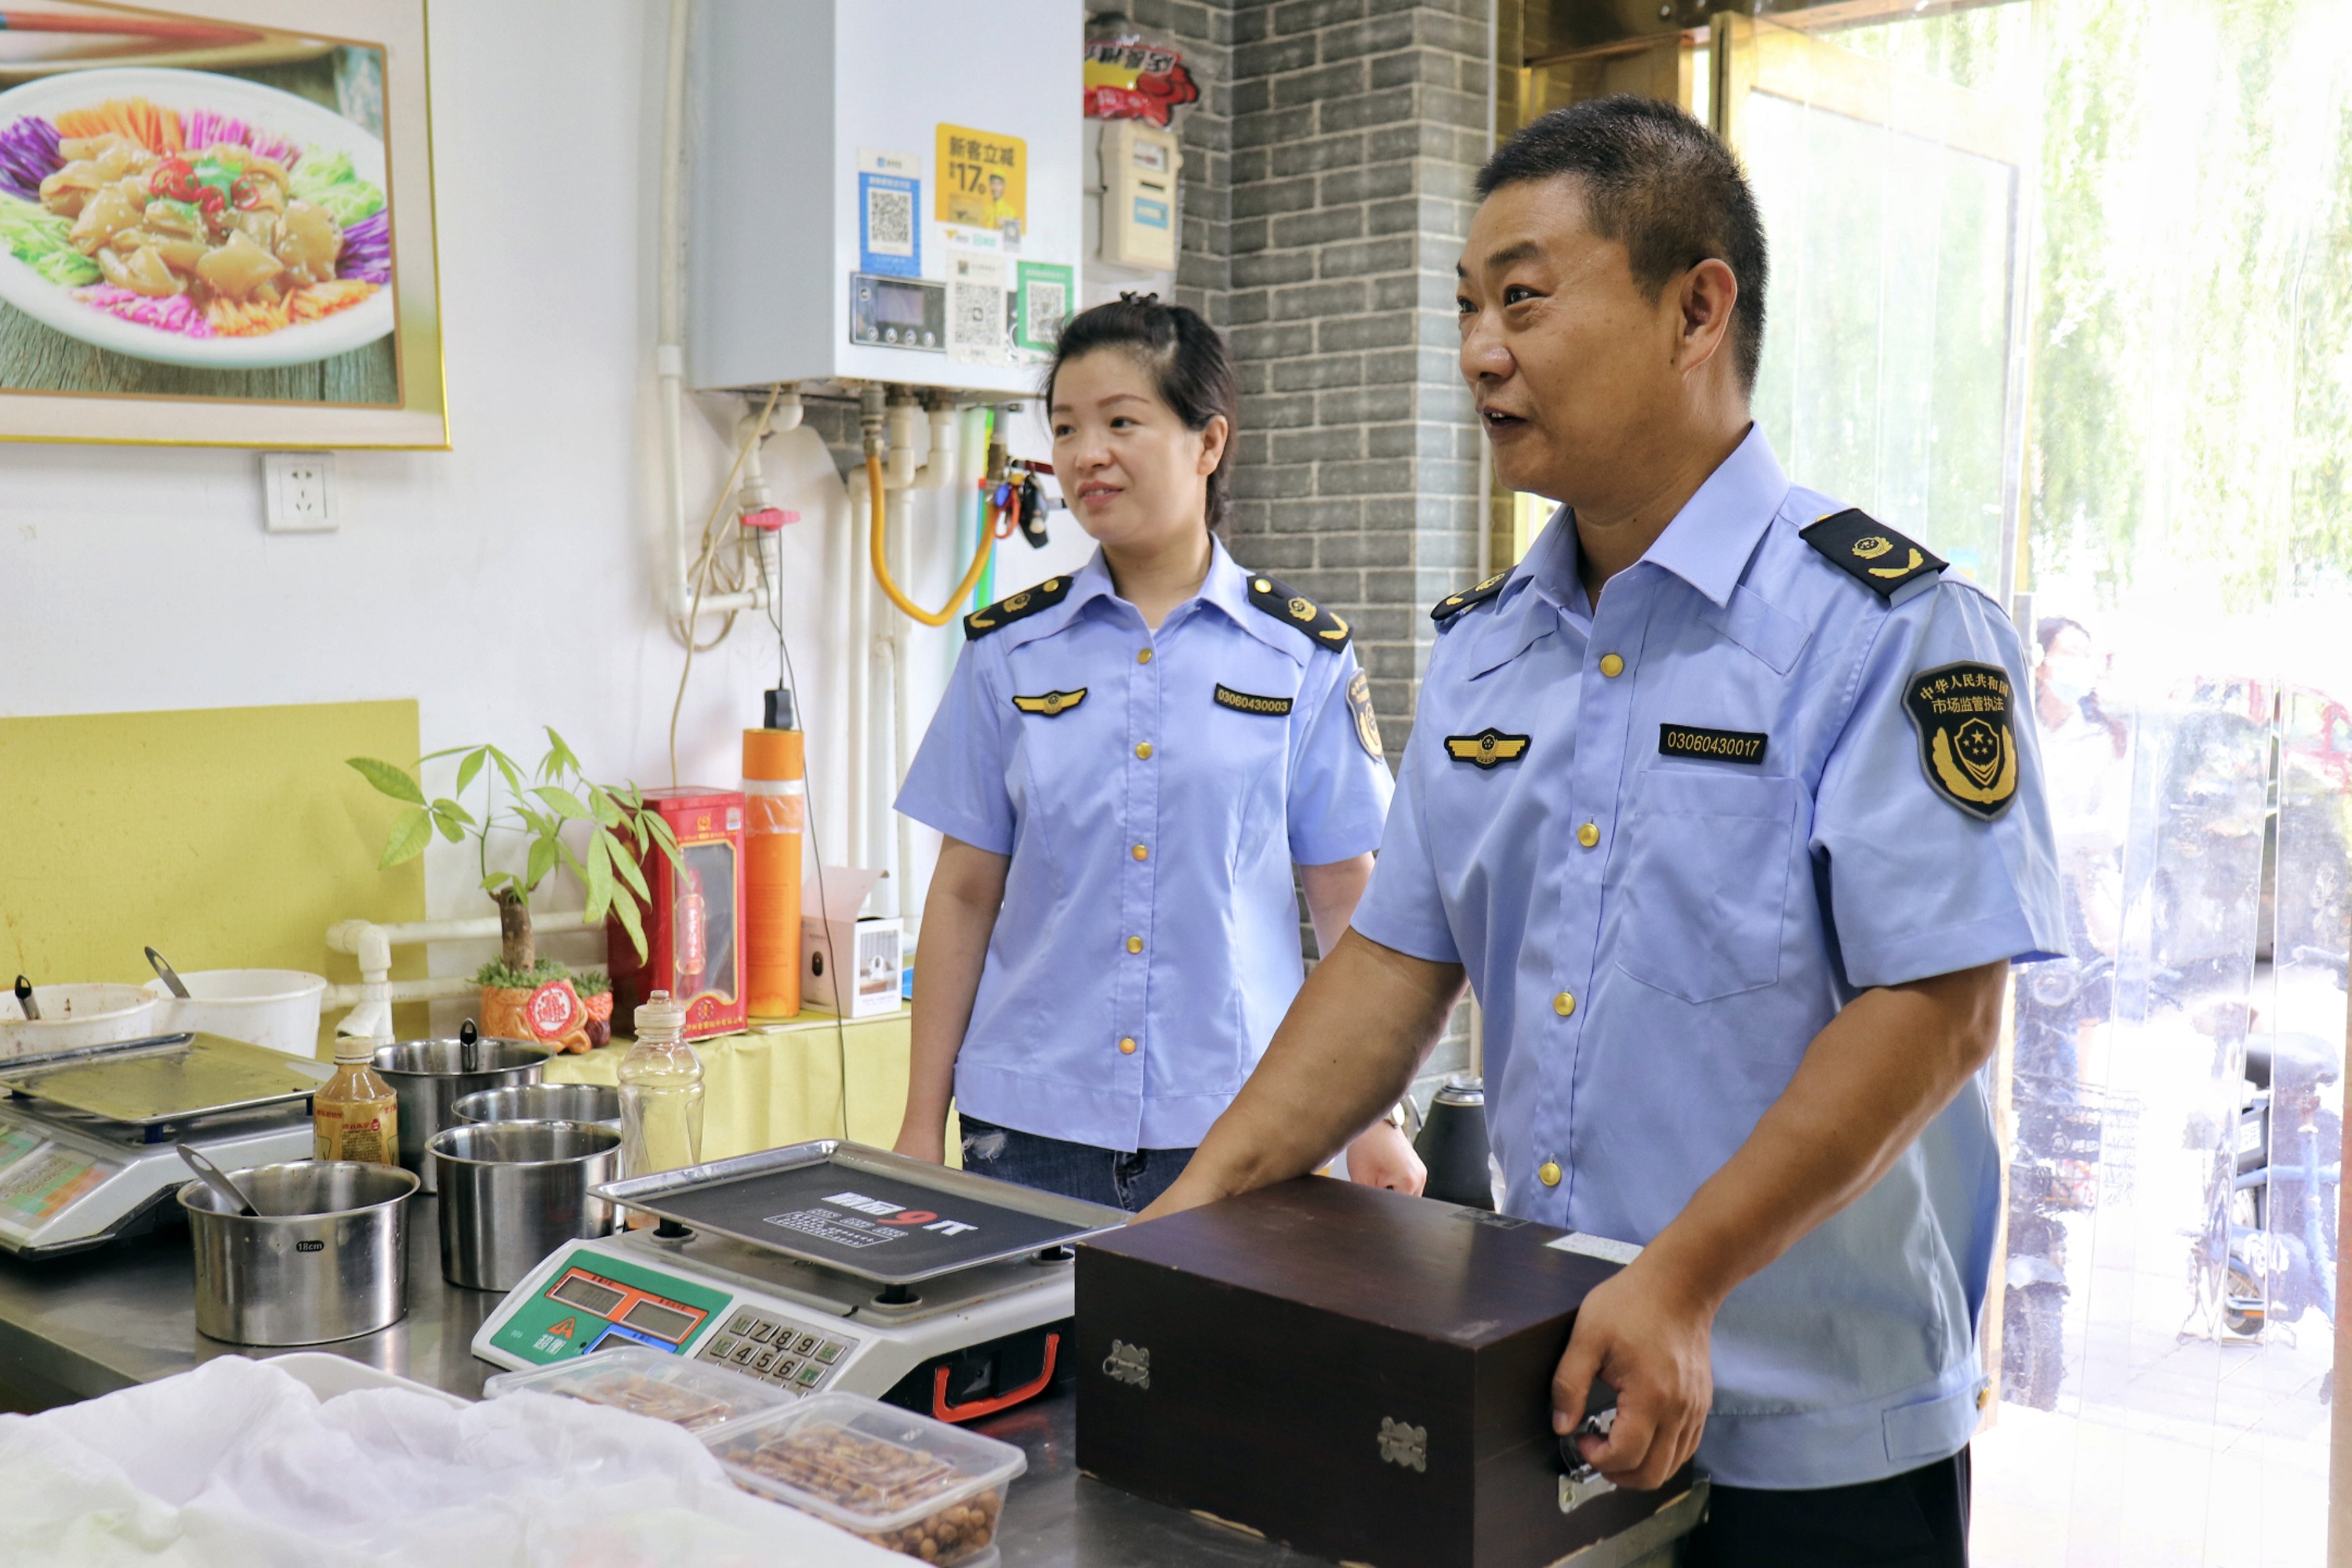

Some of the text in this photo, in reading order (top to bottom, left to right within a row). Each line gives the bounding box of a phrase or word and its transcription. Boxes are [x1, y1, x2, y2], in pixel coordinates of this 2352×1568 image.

[949, 135, 1015, 167] 新客立减
[1919, 673, 2009, 700] 中华人民共和国
[1217, 688, 1289, 712] 03060430003
[1932, 695, 2005, 714] 市场监管执法
[1668, 731, 1761, 757] 03060430017
[298, 1243, 322, 1251] 18cm
[732, 1317, 751, 1330] M1
[756, 1323, 771, 1334] 7
[775, 1330, 793, 1345] 8
[797, 1338, 814, 1352] 9
[712, 1339, 732, 1353] M2
[736, 1347, 752, 1361] 4
[757, 1352, 773, 1367] 5
[779, 1360, 795, 1375] 6
